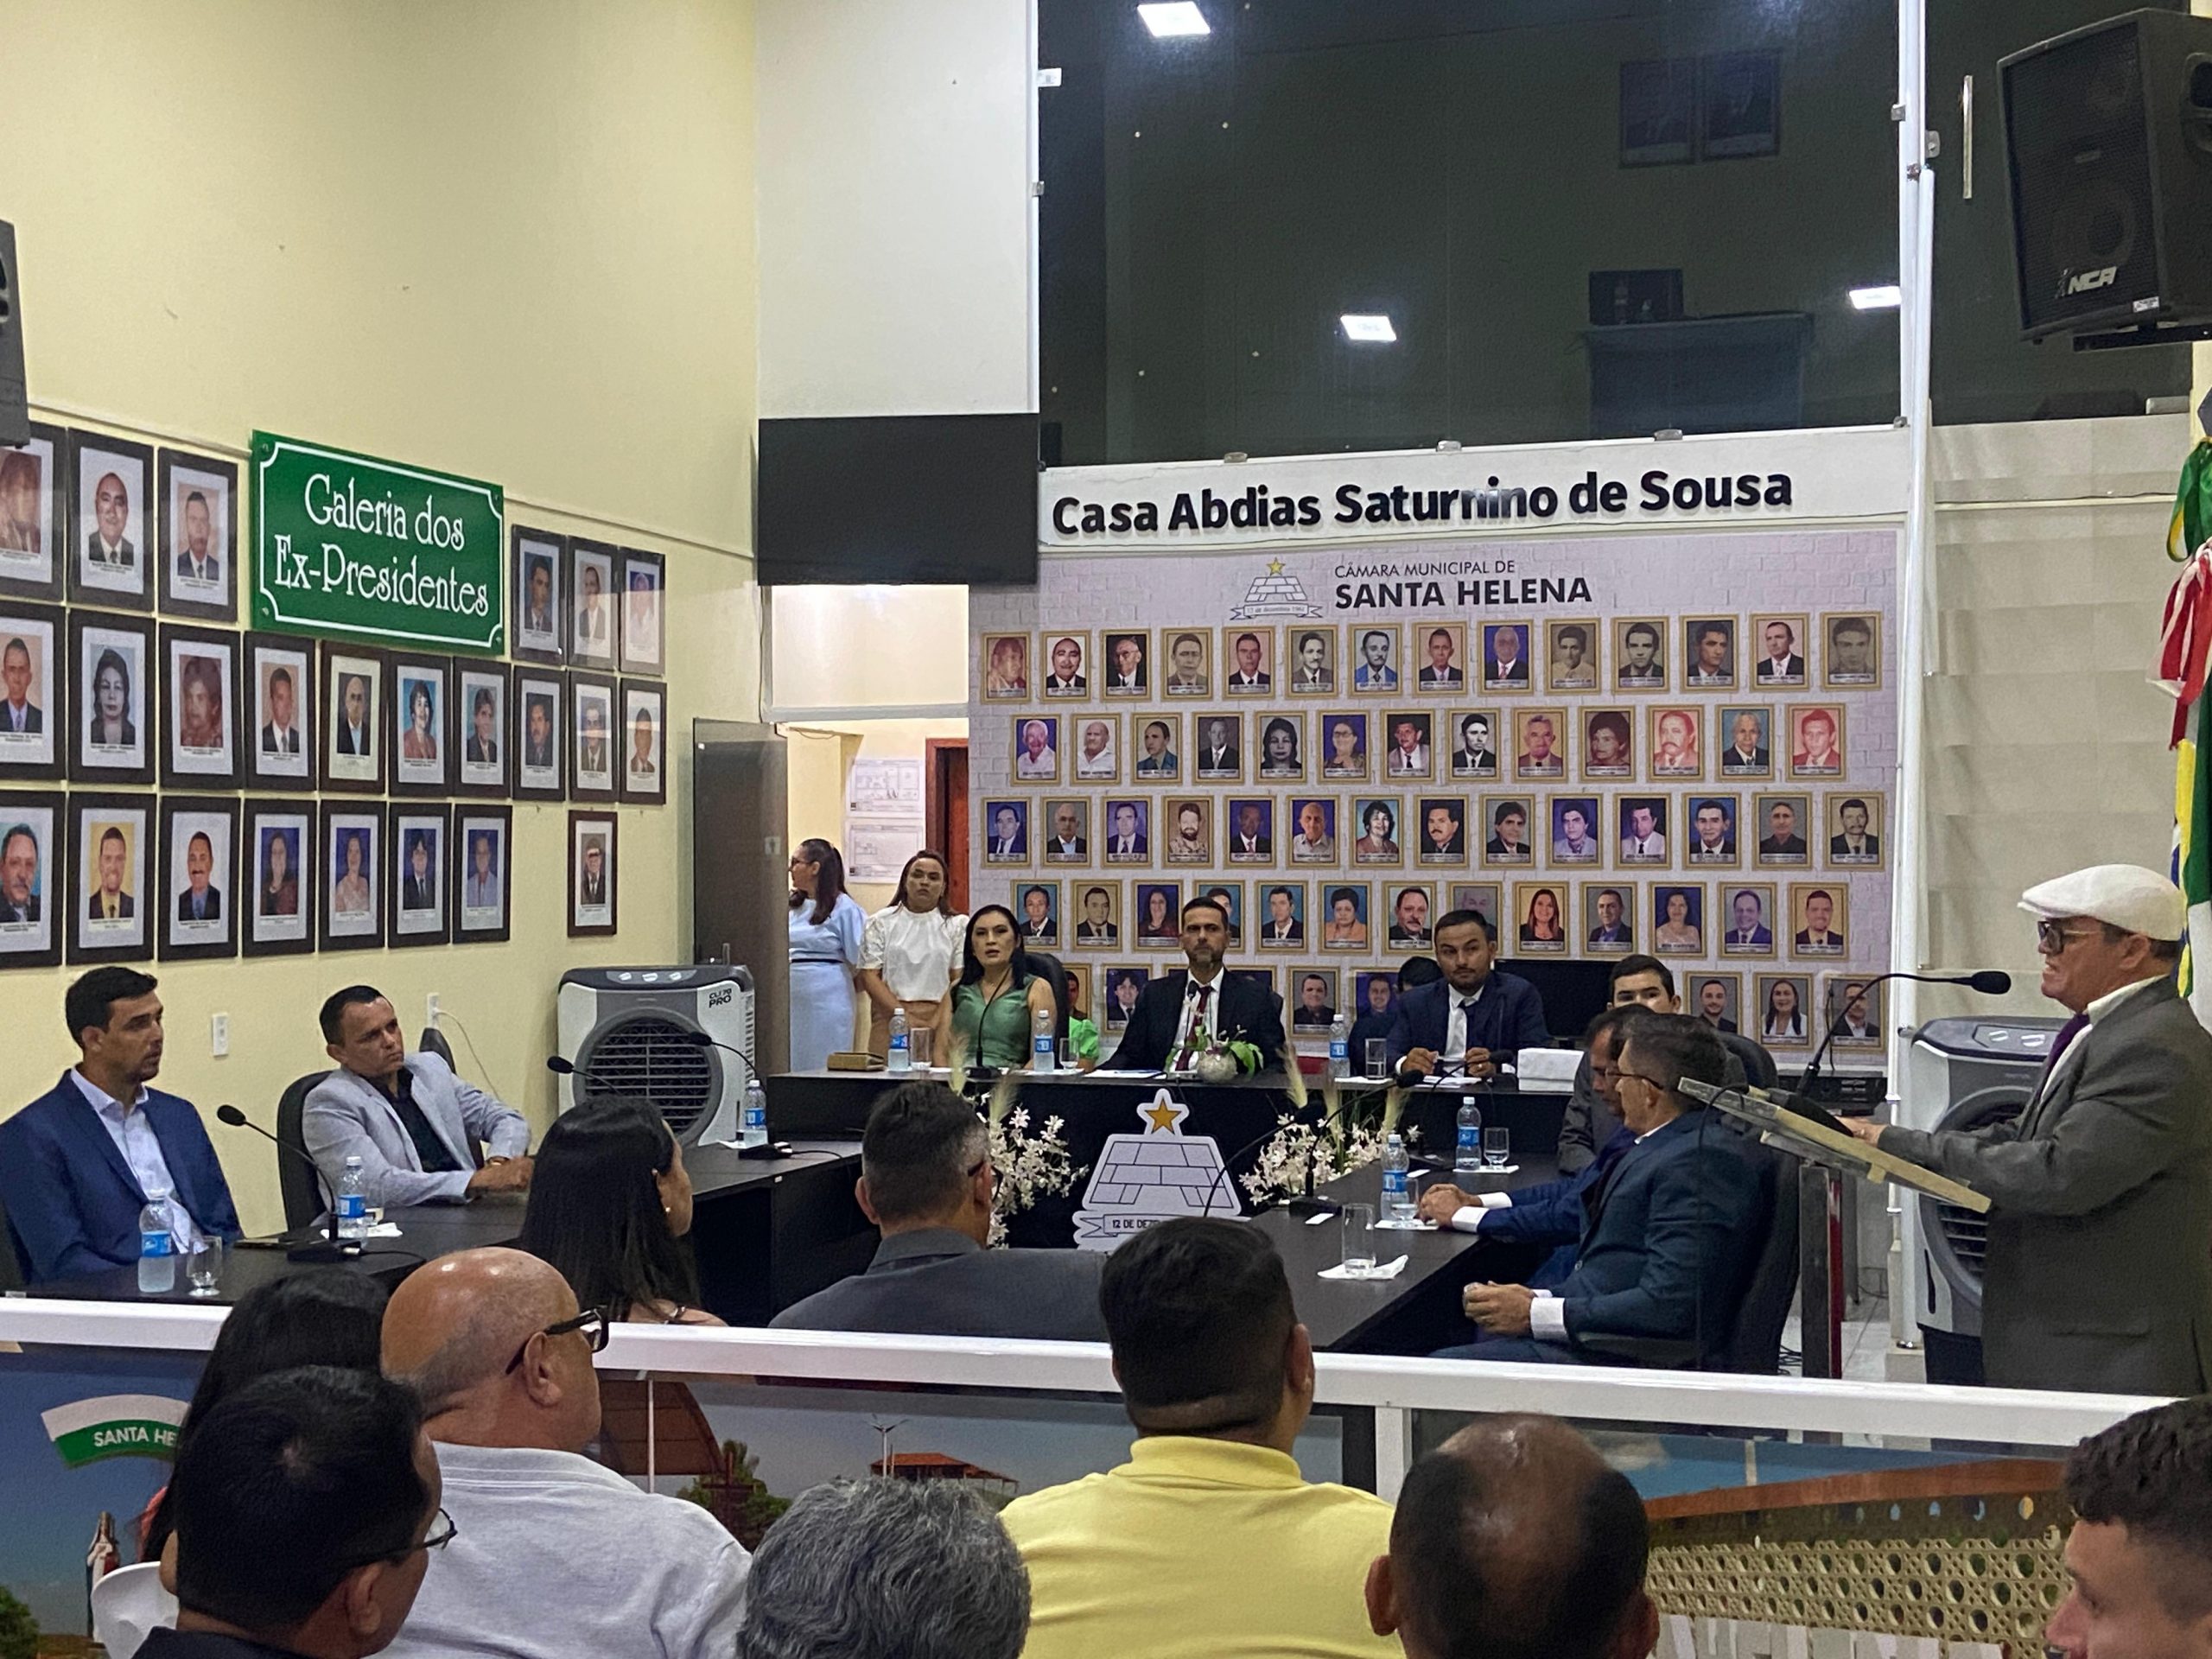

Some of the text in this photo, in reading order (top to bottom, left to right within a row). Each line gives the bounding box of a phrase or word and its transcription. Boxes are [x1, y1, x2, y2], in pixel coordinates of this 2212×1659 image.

[2068, 266, 2117, 295] NCA
[304, 474, 465, 551] Galeria dos
[1052, 470, 1793, 535] Casa Abdias Saturnino de Sousa
[274, 534, 489, 617] Ex-Presidentes
[1334, 560, 1516, 578] CÂMARA MUNICIPAL DE
[1335, 576, 1592, 609] SANTA HELENA
[709, 995, 732, 1008] PRO
[1112, 1219, 1121, 1229] 12
[1123, 1219, 1134, 1229] DE
[93, 1427, 149, 1447] SANTA
